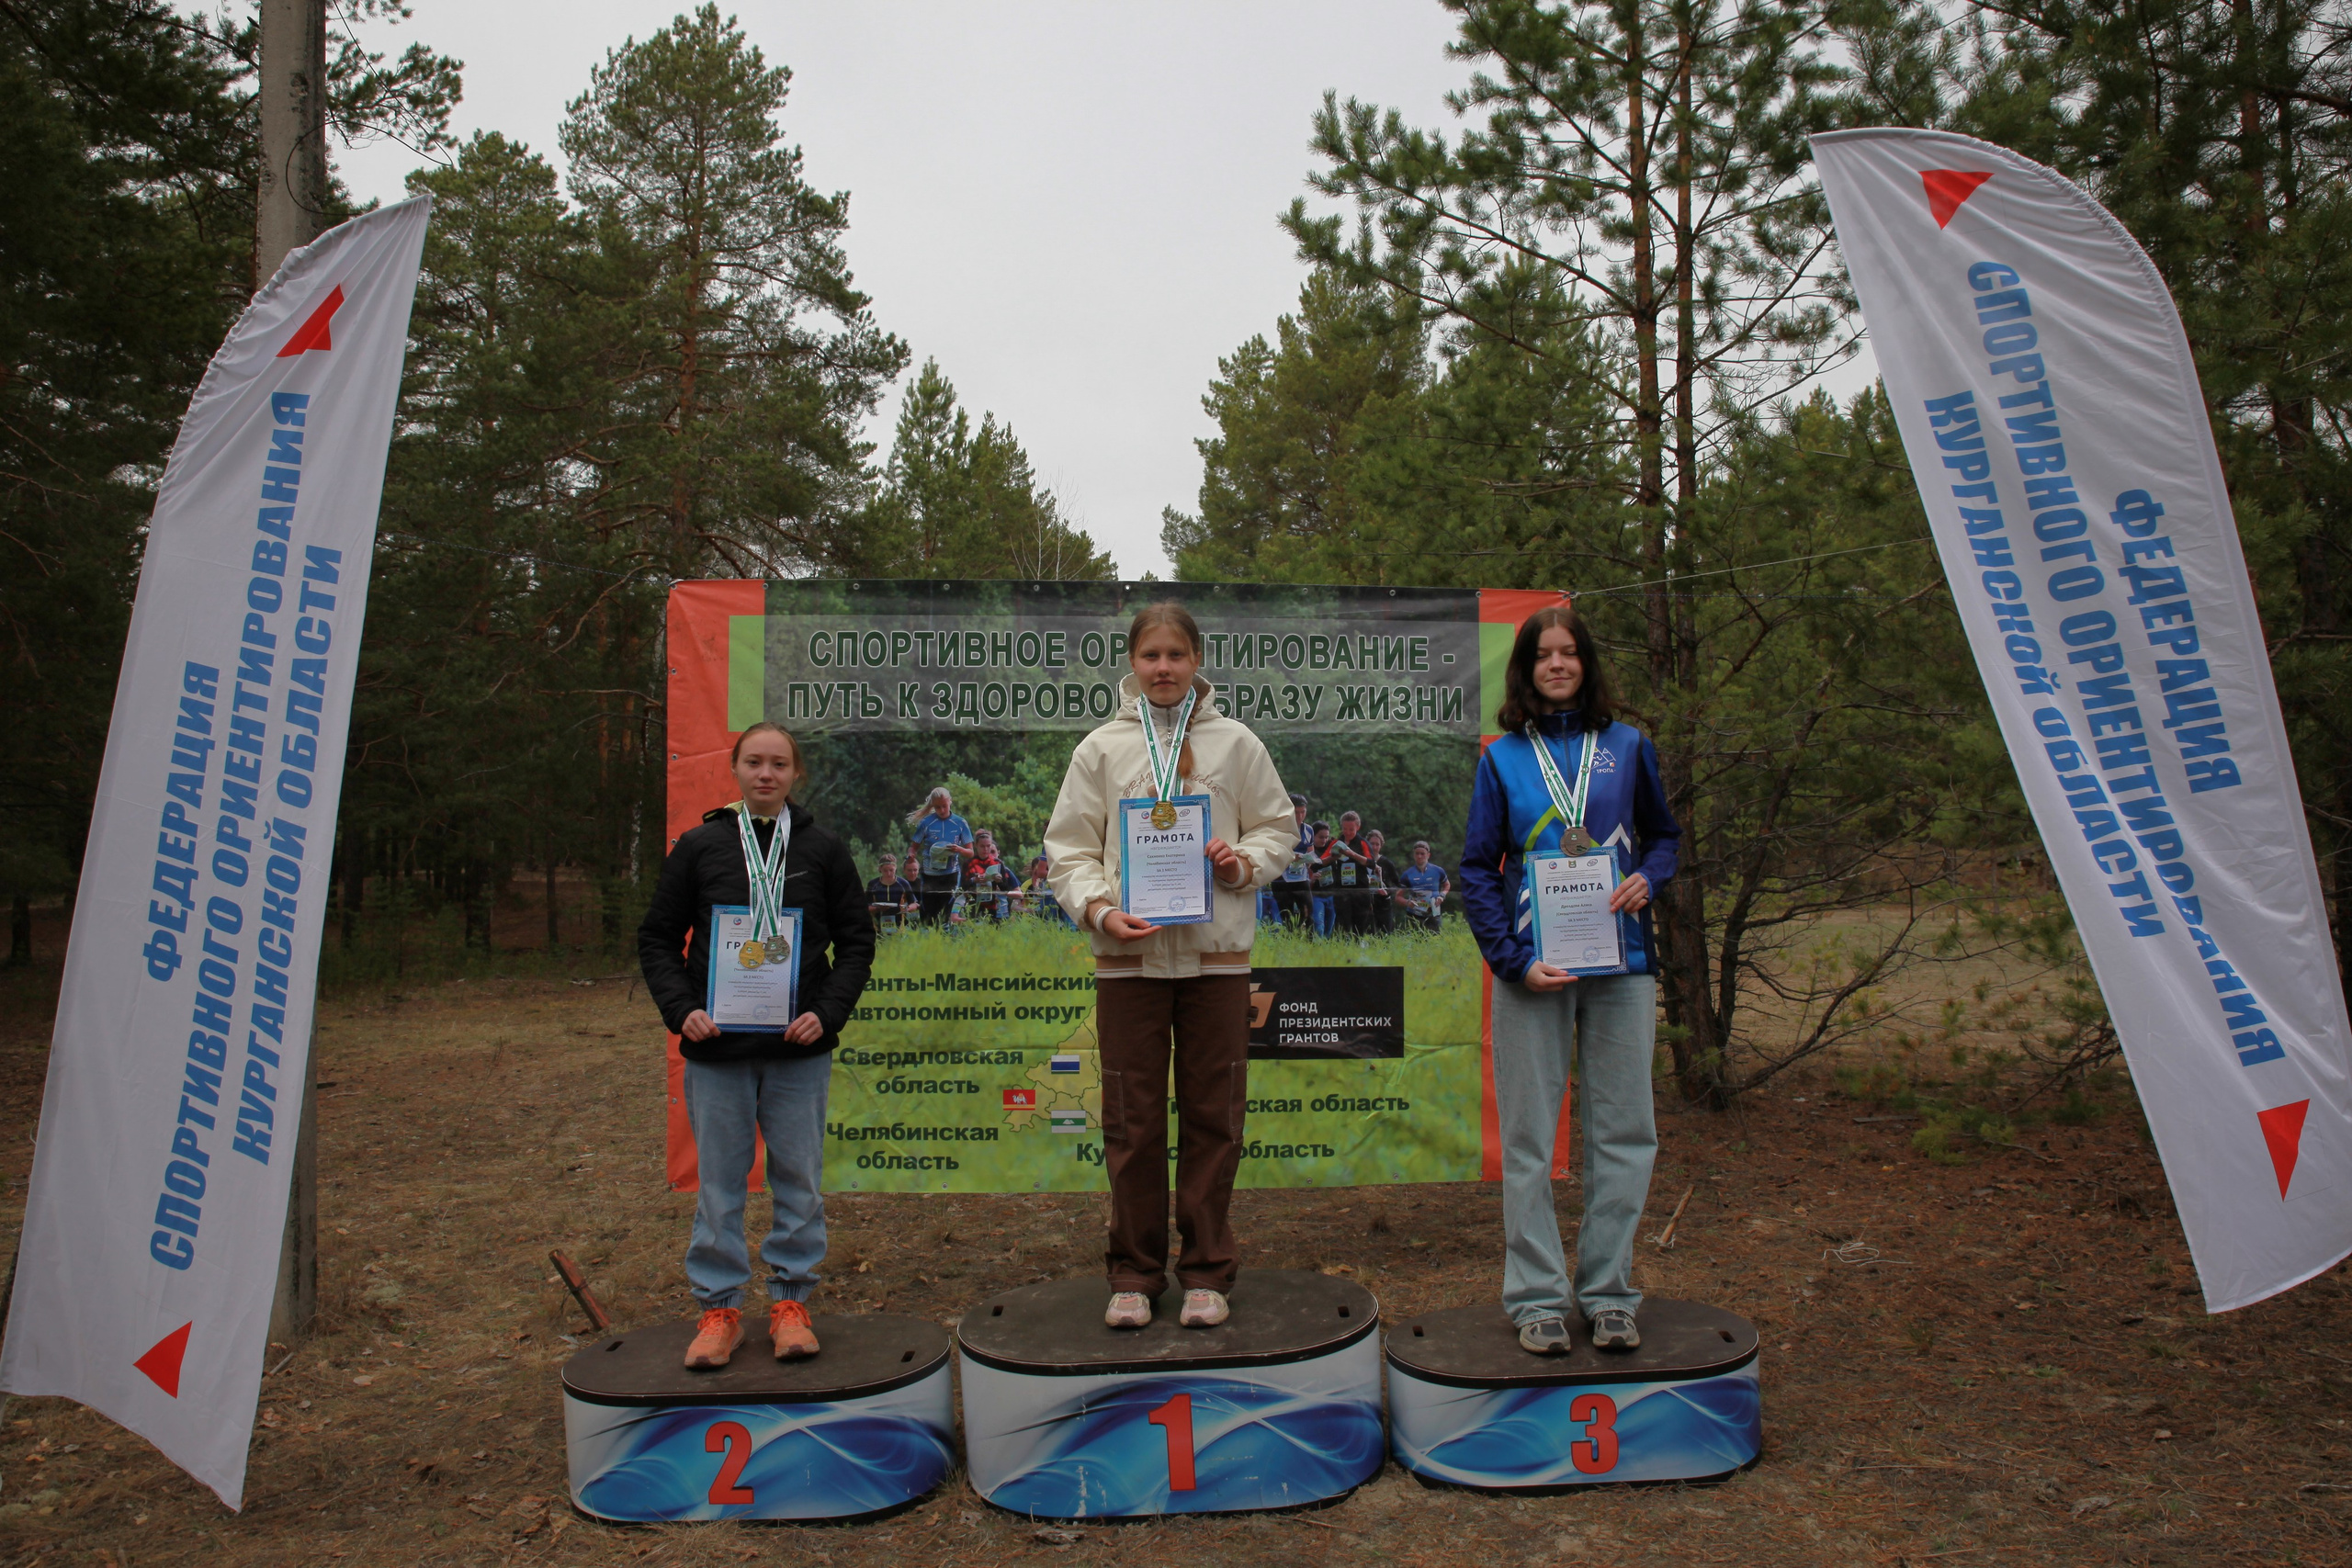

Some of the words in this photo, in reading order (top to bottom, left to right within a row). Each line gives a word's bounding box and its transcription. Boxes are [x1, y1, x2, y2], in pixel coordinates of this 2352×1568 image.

[809, 630, 1067, 668] СПОРТИВНОЕ
[1080, 631, 1430, 671] ОРТИРОВАНИЕ
[2109, 489, 2242, 794] ФЕДЕРАЦИЯ
[1924, 390, 2062, 695] КУРГАНСКОЙ
[2032, 706, 2165, 937] ОБЛАСТИ
[1967, 261, 2105, 602] СПОРТИВНОГО
[2059, 610, 2286, 1066] ОРИЕНТИРОВАНИЯ
[787, 682, 884, 719] ПУТЬ
[898, 682, 919, 719] К
[932, 682, 1120, 726] ЗДОРОВО
[1213, 683, 1326, 721] БРАЗУ
[1336, 686, 1463, 723] ЖИЗНИ
[143, 660, 220, 982] ФЕДЕРАЦИЯ
[150, 896, 243, 1270] СПОРТИВНОГО
[211, 391, 311, 887] ОРИЕНТИРОВАНИЯ
[1136, 833, 1194, 844] ГРАМОТА
[232, 818, 308, 1166] КУРГАНСКОЙ
[277, 545, 343, 808] ОБЛАСТИ
[1545, 883, 1603, 895] ГРАМОТА
[864, 972, 1097, 992] анты-Мансийский
[846, 1001, 1006, 1021] автономный
[1014, 1005, 1086, 1024] округ
[1279, 1002, 1317, 1013] ФОНД
[1279, 1017, 1392, 1030] ПРЕЗИДЕНТСКИХ
[1279, 1032, 1339, 1043] ГРАНТОВ
[839, 1047, 1023, 1069] Свердловская
[876, 1076, 979, 1094] область
[1310, 1093, 1410, 1112] область
[827, 1122, 999, 1141] Челябинская
[856, 1151, 959, 1170] область
[1148, 1393, 1195, 1491] 1
[1570, 1393, 1618, 1473] 3
[705, 1422, 753, 1505] 2
